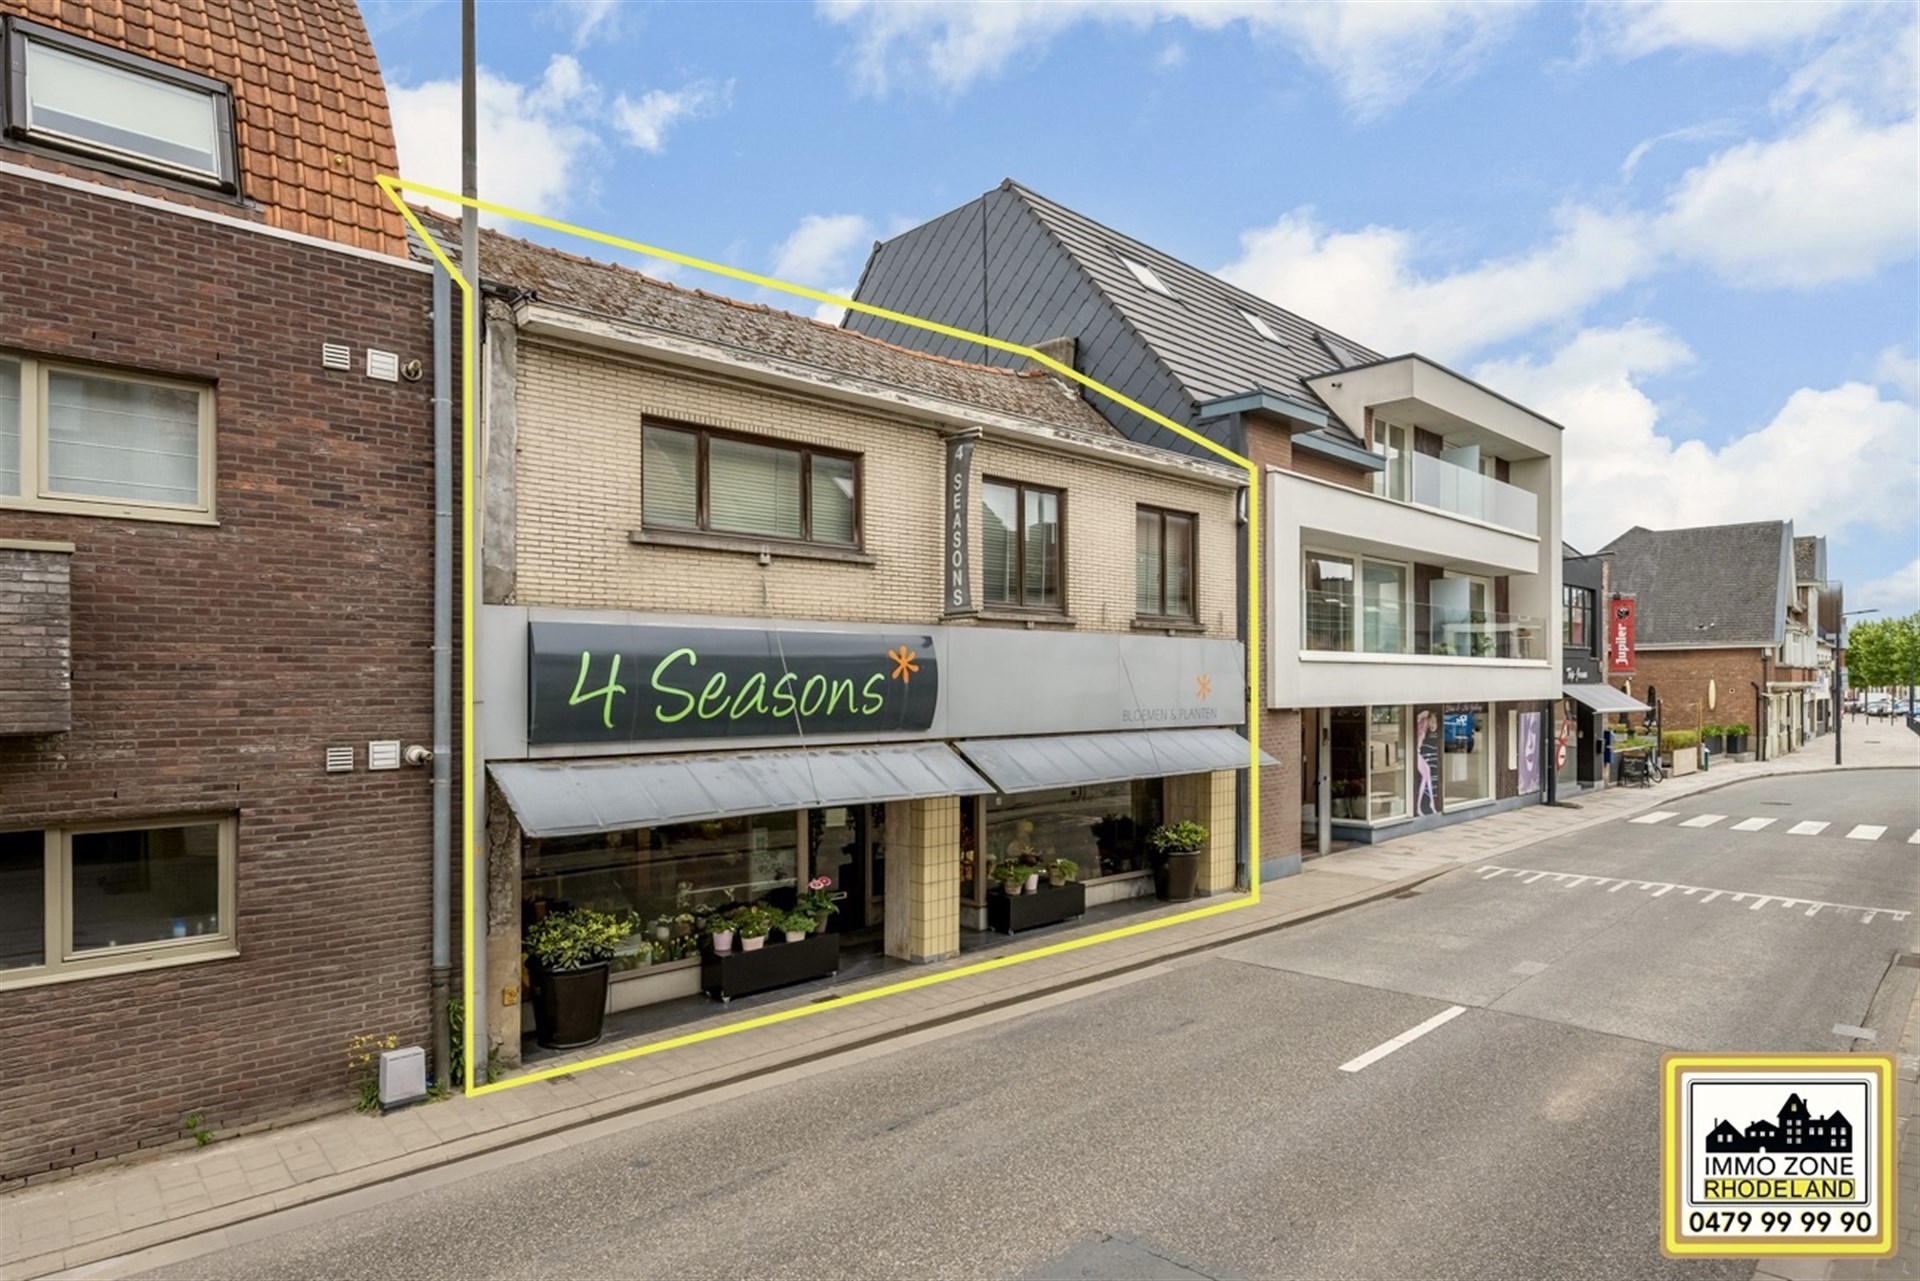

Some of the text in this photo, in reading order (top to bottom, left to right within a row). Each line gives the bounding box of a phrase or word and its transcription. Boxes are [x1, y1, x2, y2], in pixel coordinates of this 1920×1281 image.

[952, 445, 963, 606] 4 SEASONS
[1615, 623, 1629, 666] Jupiler
[568, 648, 886, 729] 4 Seasons
[1122, 707, 1217, 722] BLOEMEN & PLANTEN
